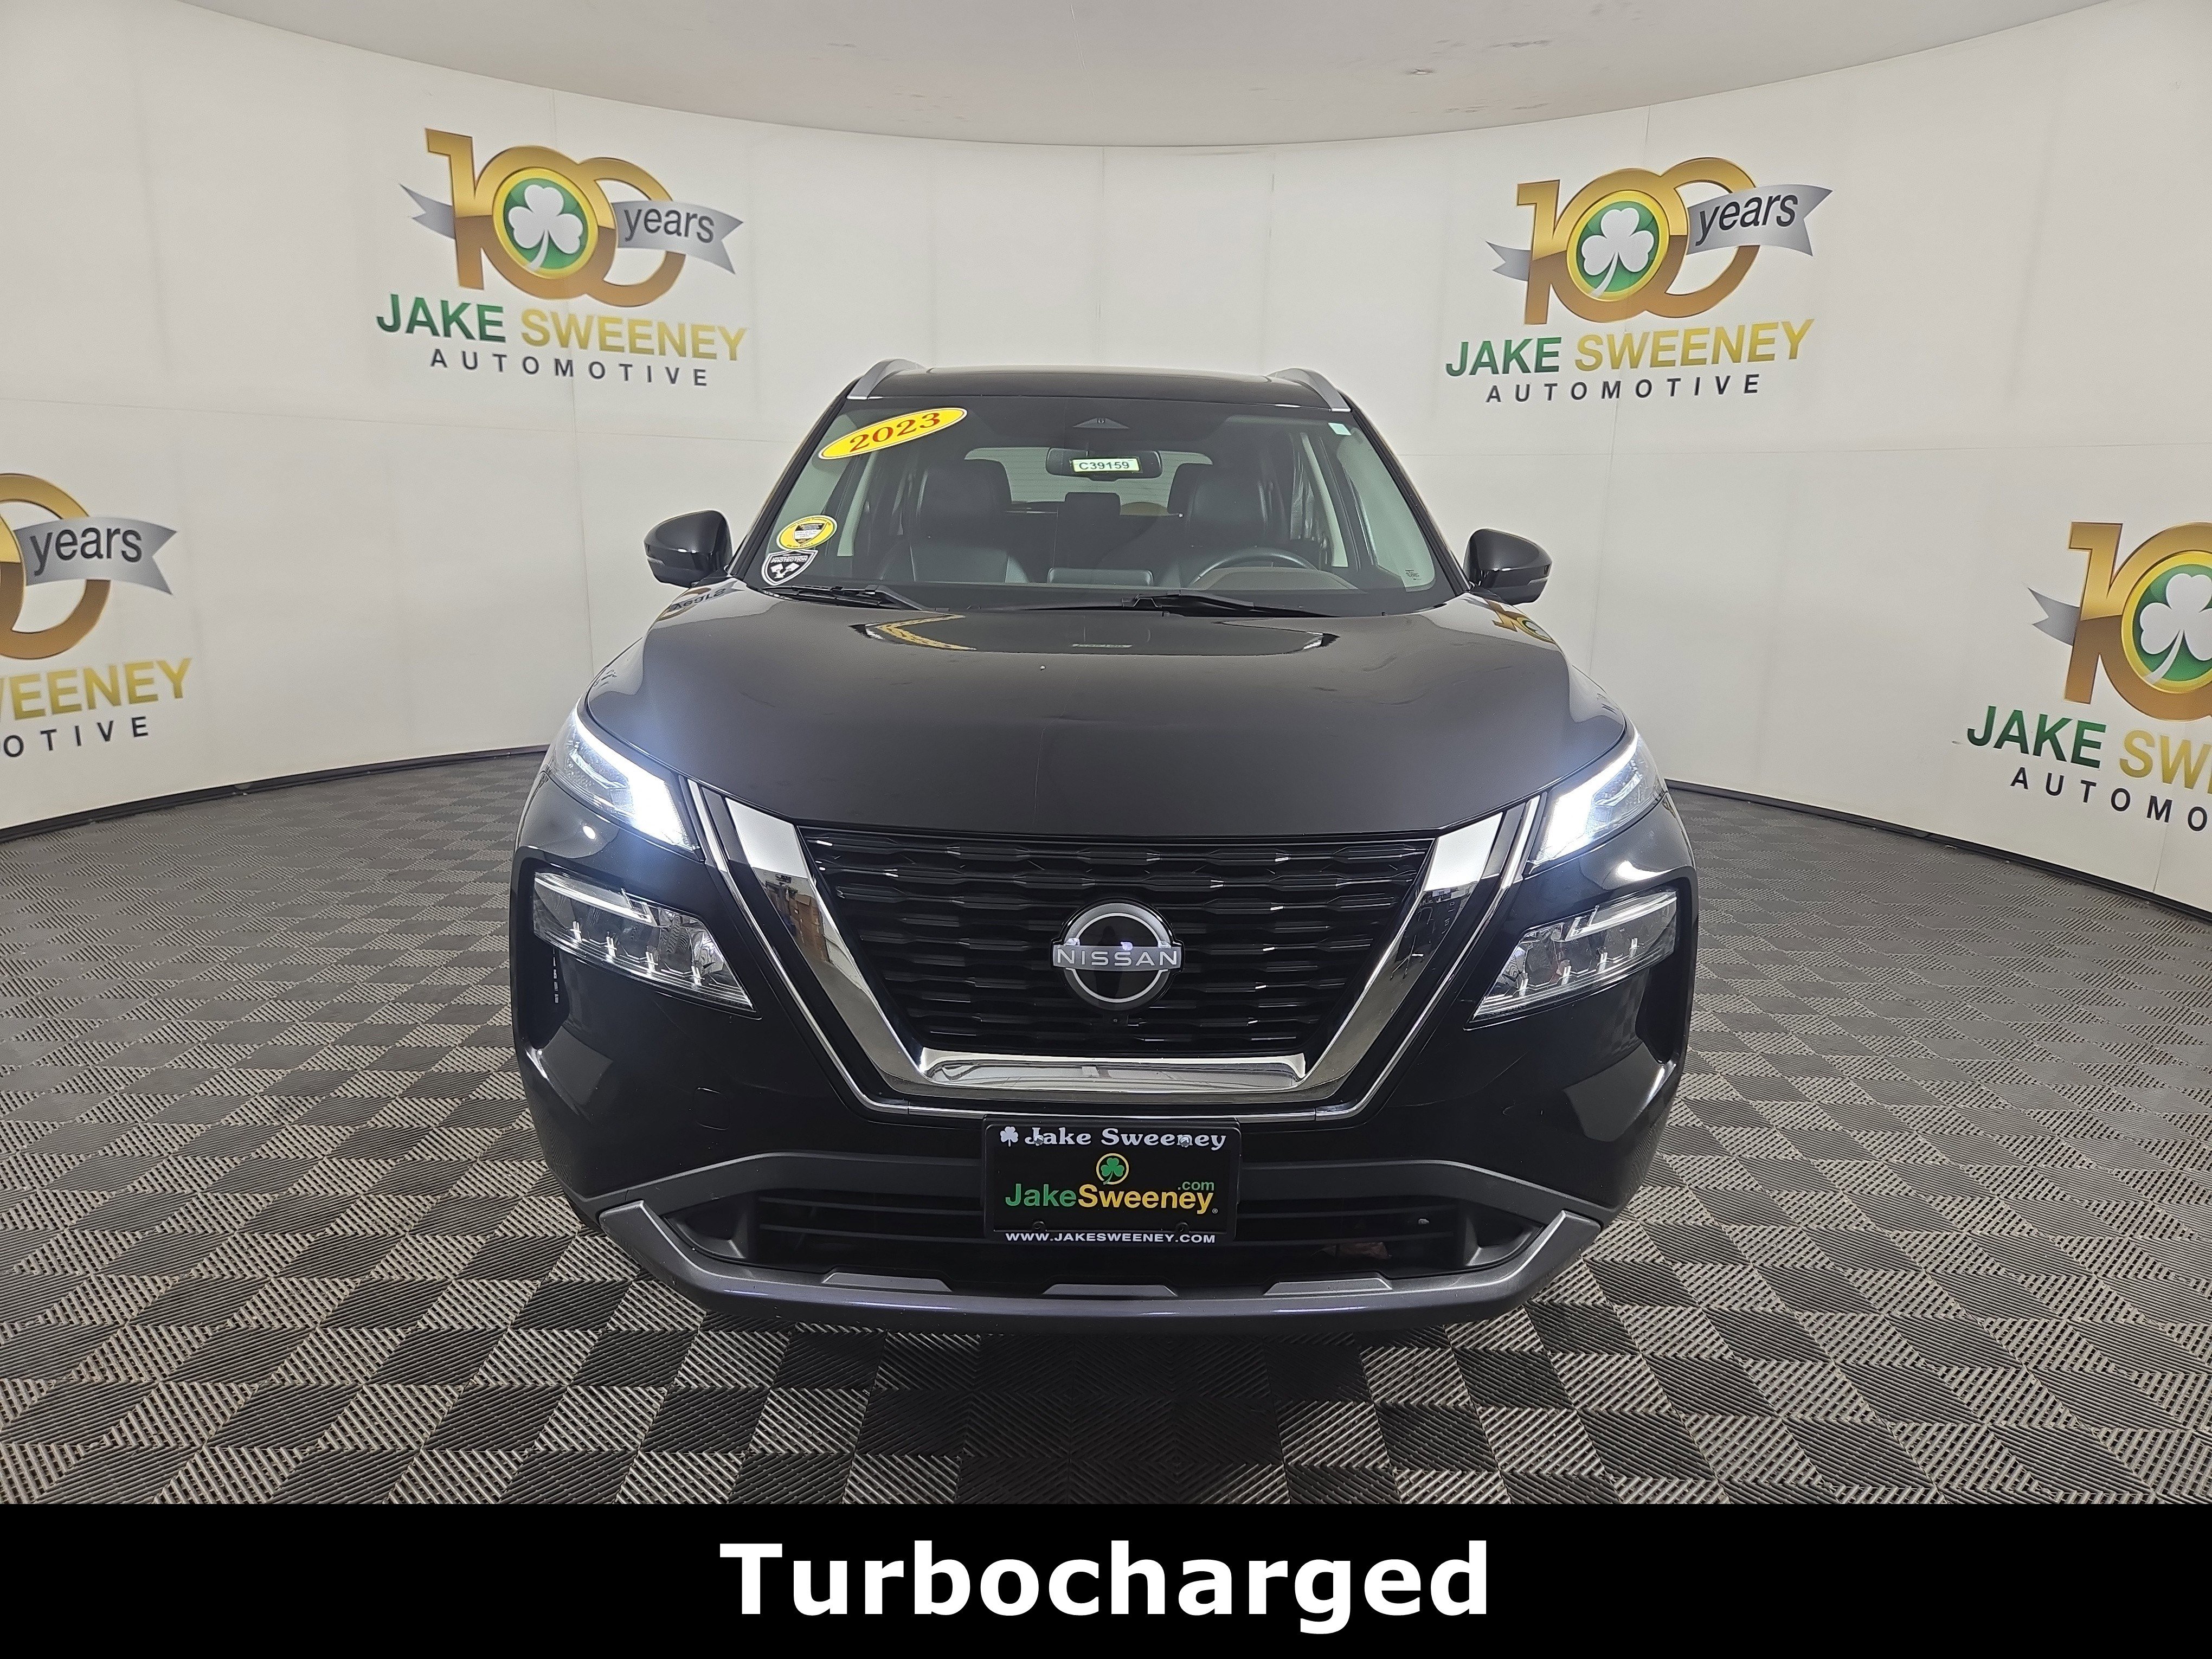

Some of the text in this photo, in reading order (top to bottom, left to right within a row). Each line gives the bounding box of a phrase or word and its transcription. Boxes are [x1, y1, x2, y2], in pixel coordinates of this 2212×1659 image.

[425, 128, 686, 307] 100
[623, 208, 715, 243] years
[1695, 194, 1798, 246] years
[1517, 157, 1760, 325] 100
[376, 293, 748, 362] JAKE SWEENEY
[1445, 318, 1815, 376] JAKE SWEENEY
[430, 349, 708, 387] AUTOMOTIVE
[1486, 374, 1759, 403] AUTOMOTIVE
[849, 412, 941, 453] 2023
[1079, 461, 1129, 470] C39159
[30, 526, 143, 576] years
[1967, 705, 2212, 795] JAKE SW
[1057, 949, 1177, 966] NISSAN
[1024, 1127, 1091, 1146] Jake
[1005, 1184, 1214, 1214] JakeSweeney
[1178, 1181, 1214, 1191] .com
[1005, 1233, 1216, 1243] WWW.JAKESWEENEY.COM
